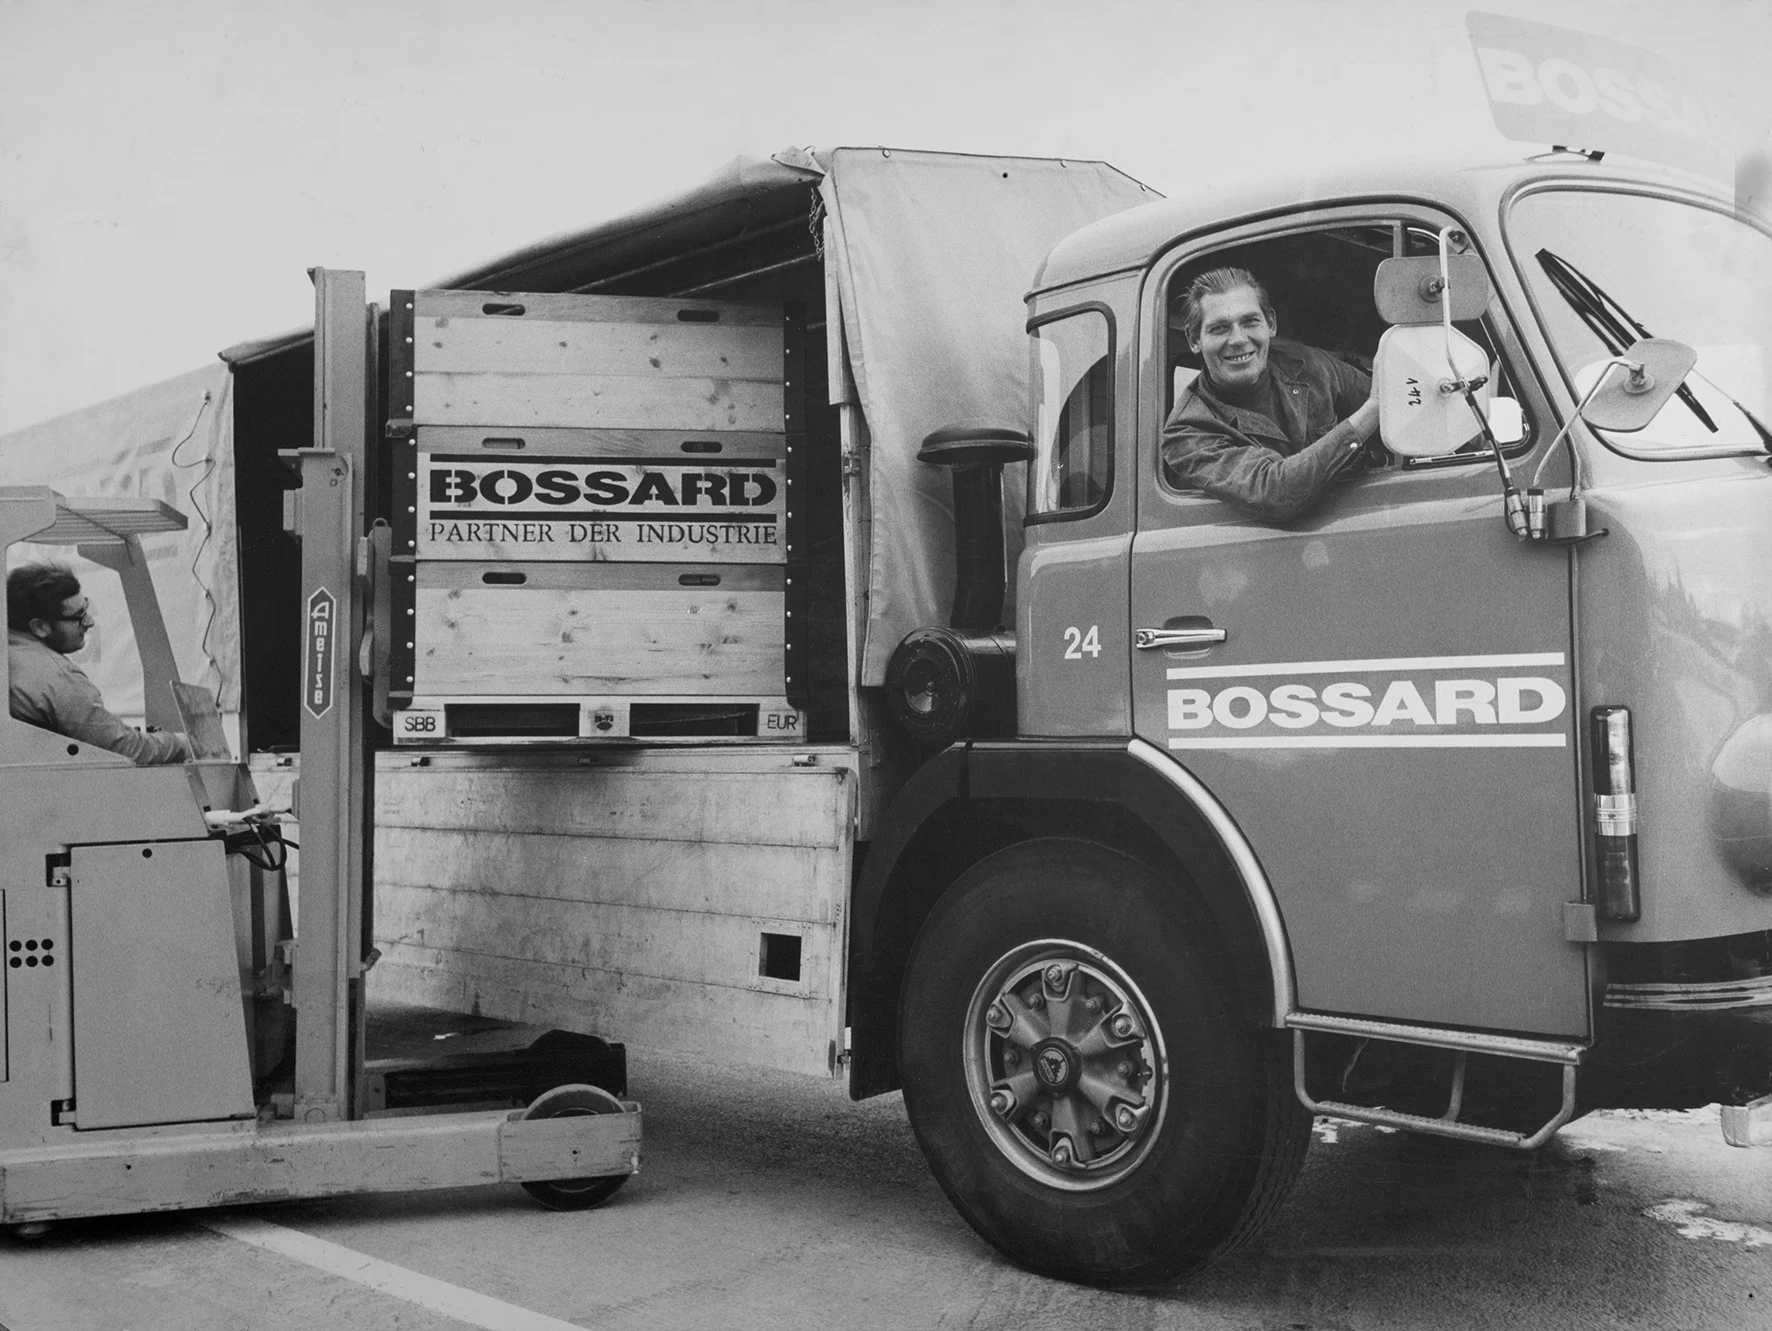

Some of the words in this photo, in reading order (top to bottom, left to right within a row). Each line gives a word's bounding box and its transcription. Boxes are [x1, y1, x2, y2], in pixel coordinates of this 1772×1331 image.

[430, 469, 777, 506] BOSSARD
[430, 523, 554, 543] PARTNER
[569, 523, 621, 543] DER
[637, 524, 777, 544] INDUSTRIE
[311, 601, 330, 705] Ameise
[1064, 626, 1102, 660] 24
[1167, 677, 1566, 730] BOSSARD
[404, 716, 436, 732] SBB
[767, 714, 797, 731] EUR
